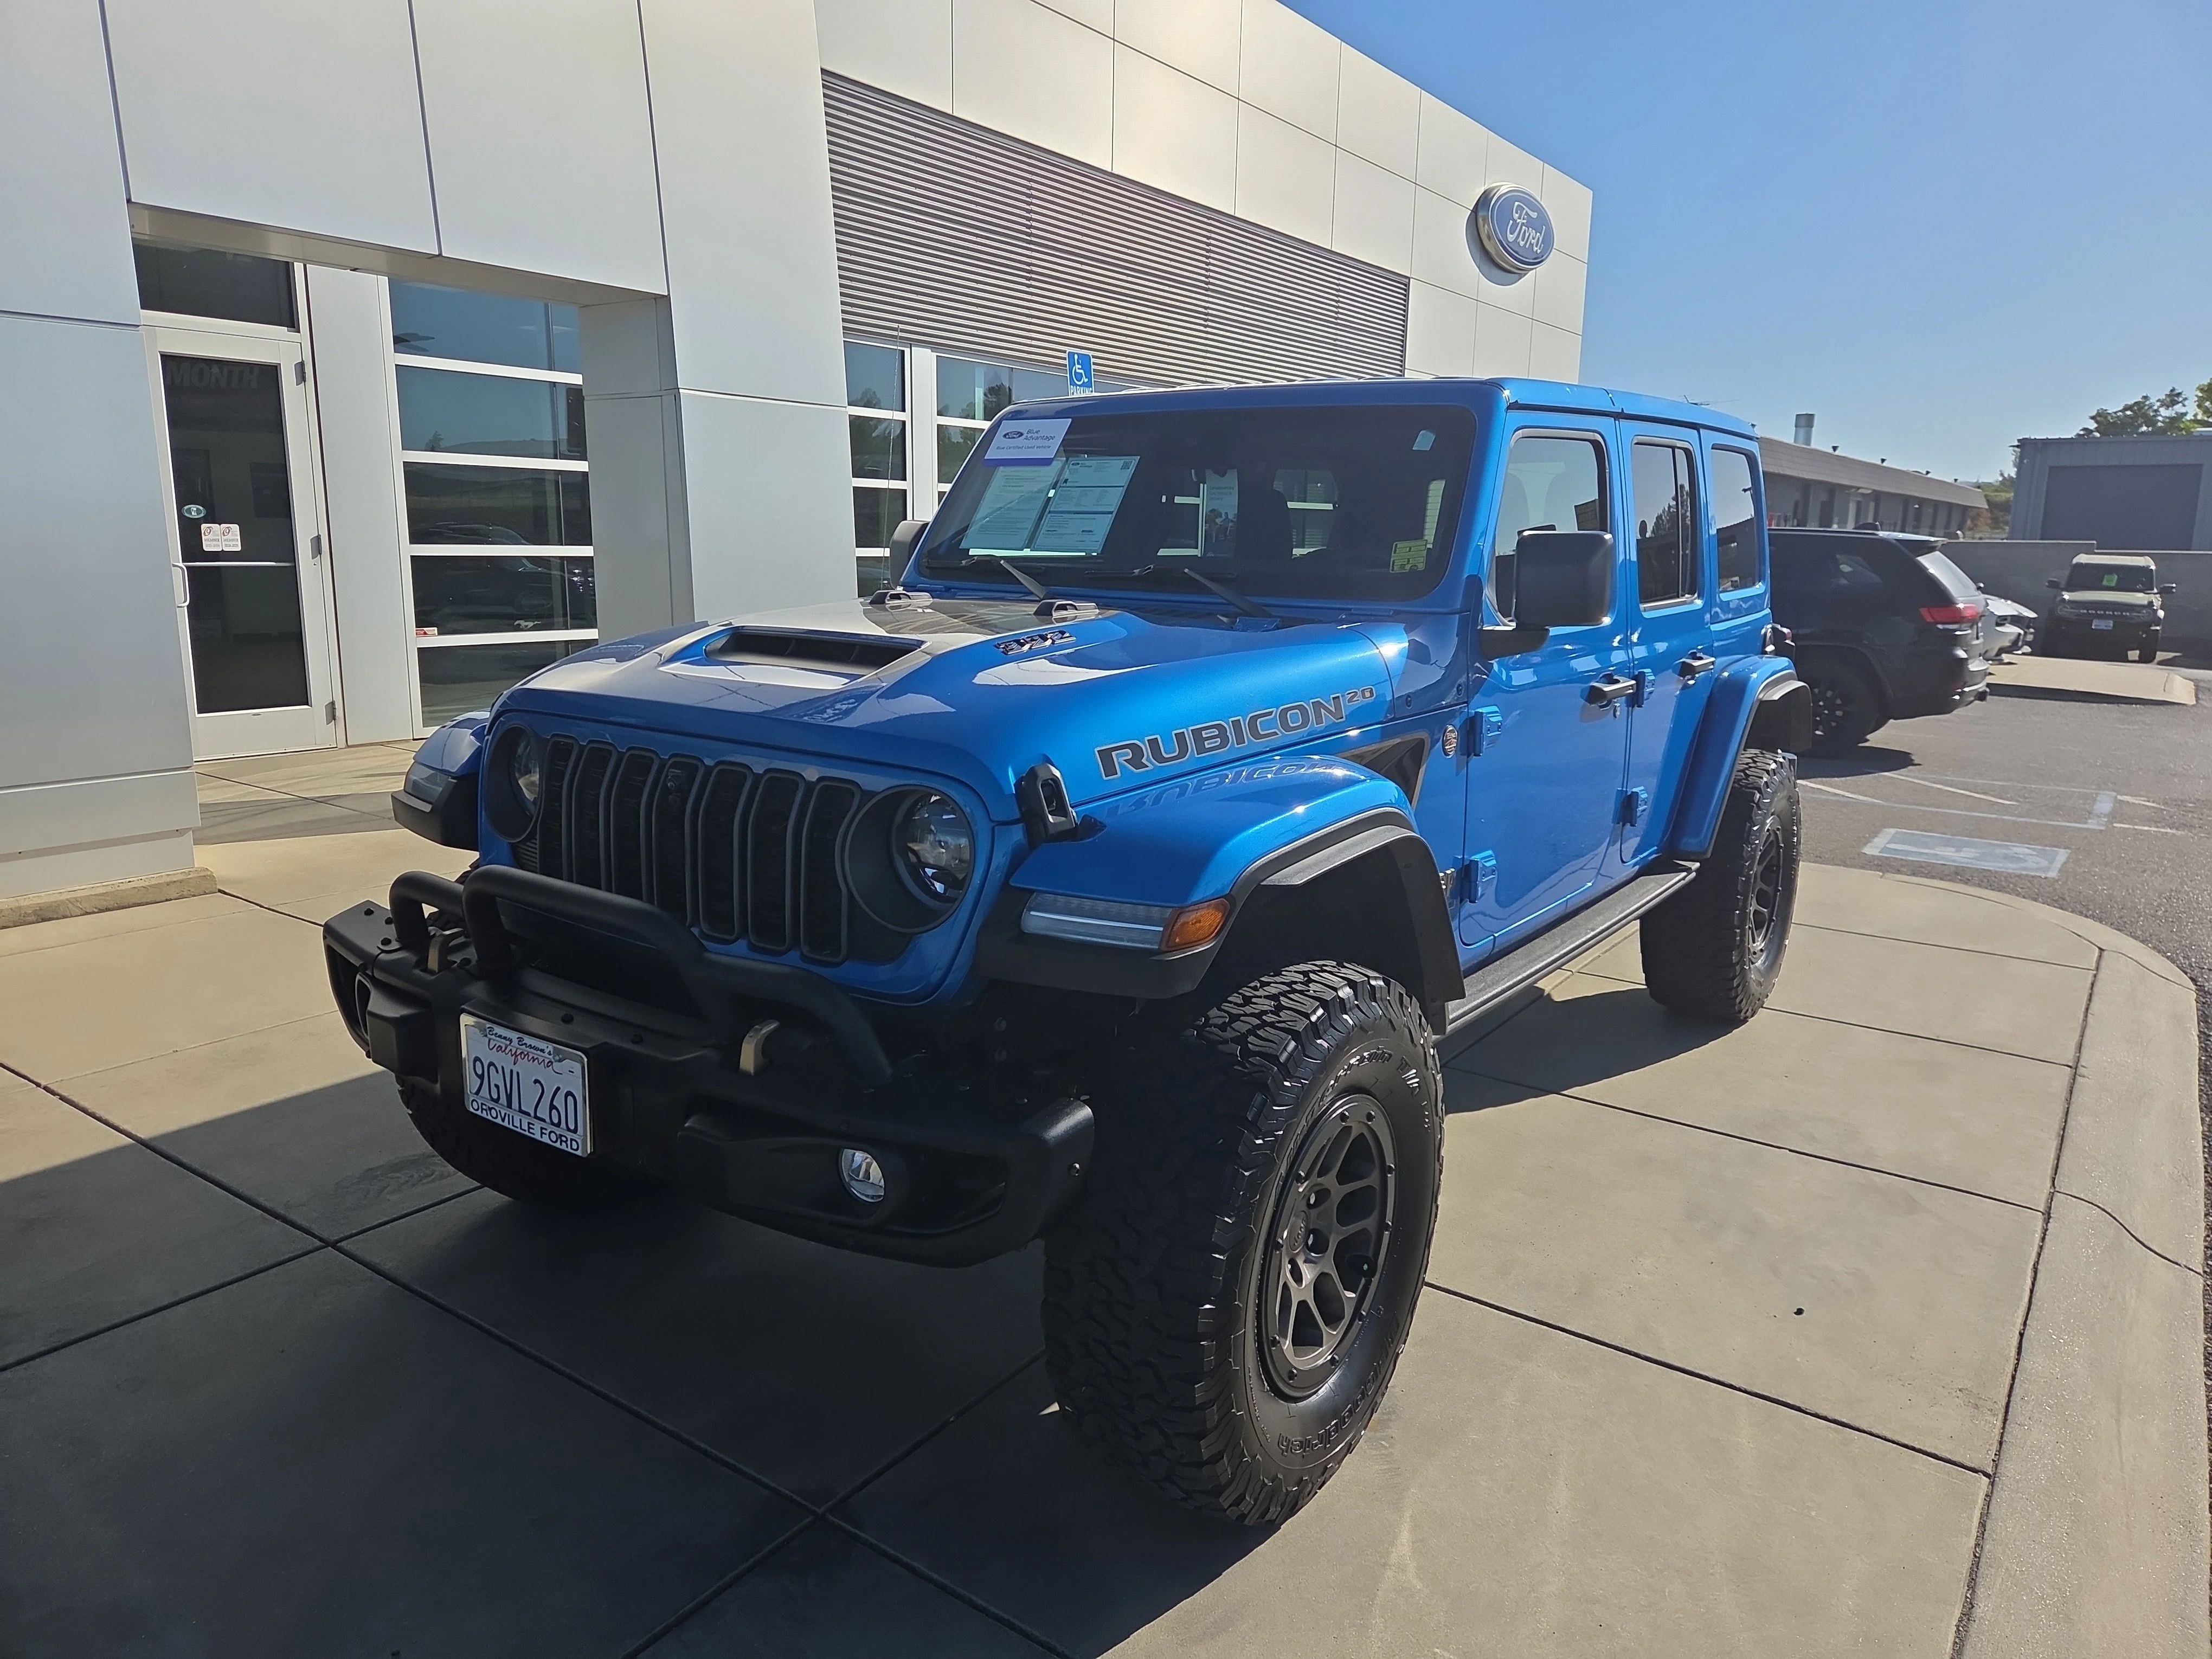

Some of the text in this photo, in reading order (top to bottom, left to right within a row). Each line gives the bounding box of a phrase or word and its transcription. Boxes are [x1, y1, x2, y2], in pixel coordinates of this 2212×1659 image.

[1507, 201, 1546, 255] Ford
[168, 361, 260, 389] MONTH
[993, 629, 1076, 655] 392
[1094, 686, 1375, 780] RUBICON 20
[486, 1026, 553, 1057] Benny Brown's
[487, 1039, 563, 1076] California
[473, 1056, 578, 1135] 9GVL260
[471, 1098, 580, 1153] OROVILLE FORD
